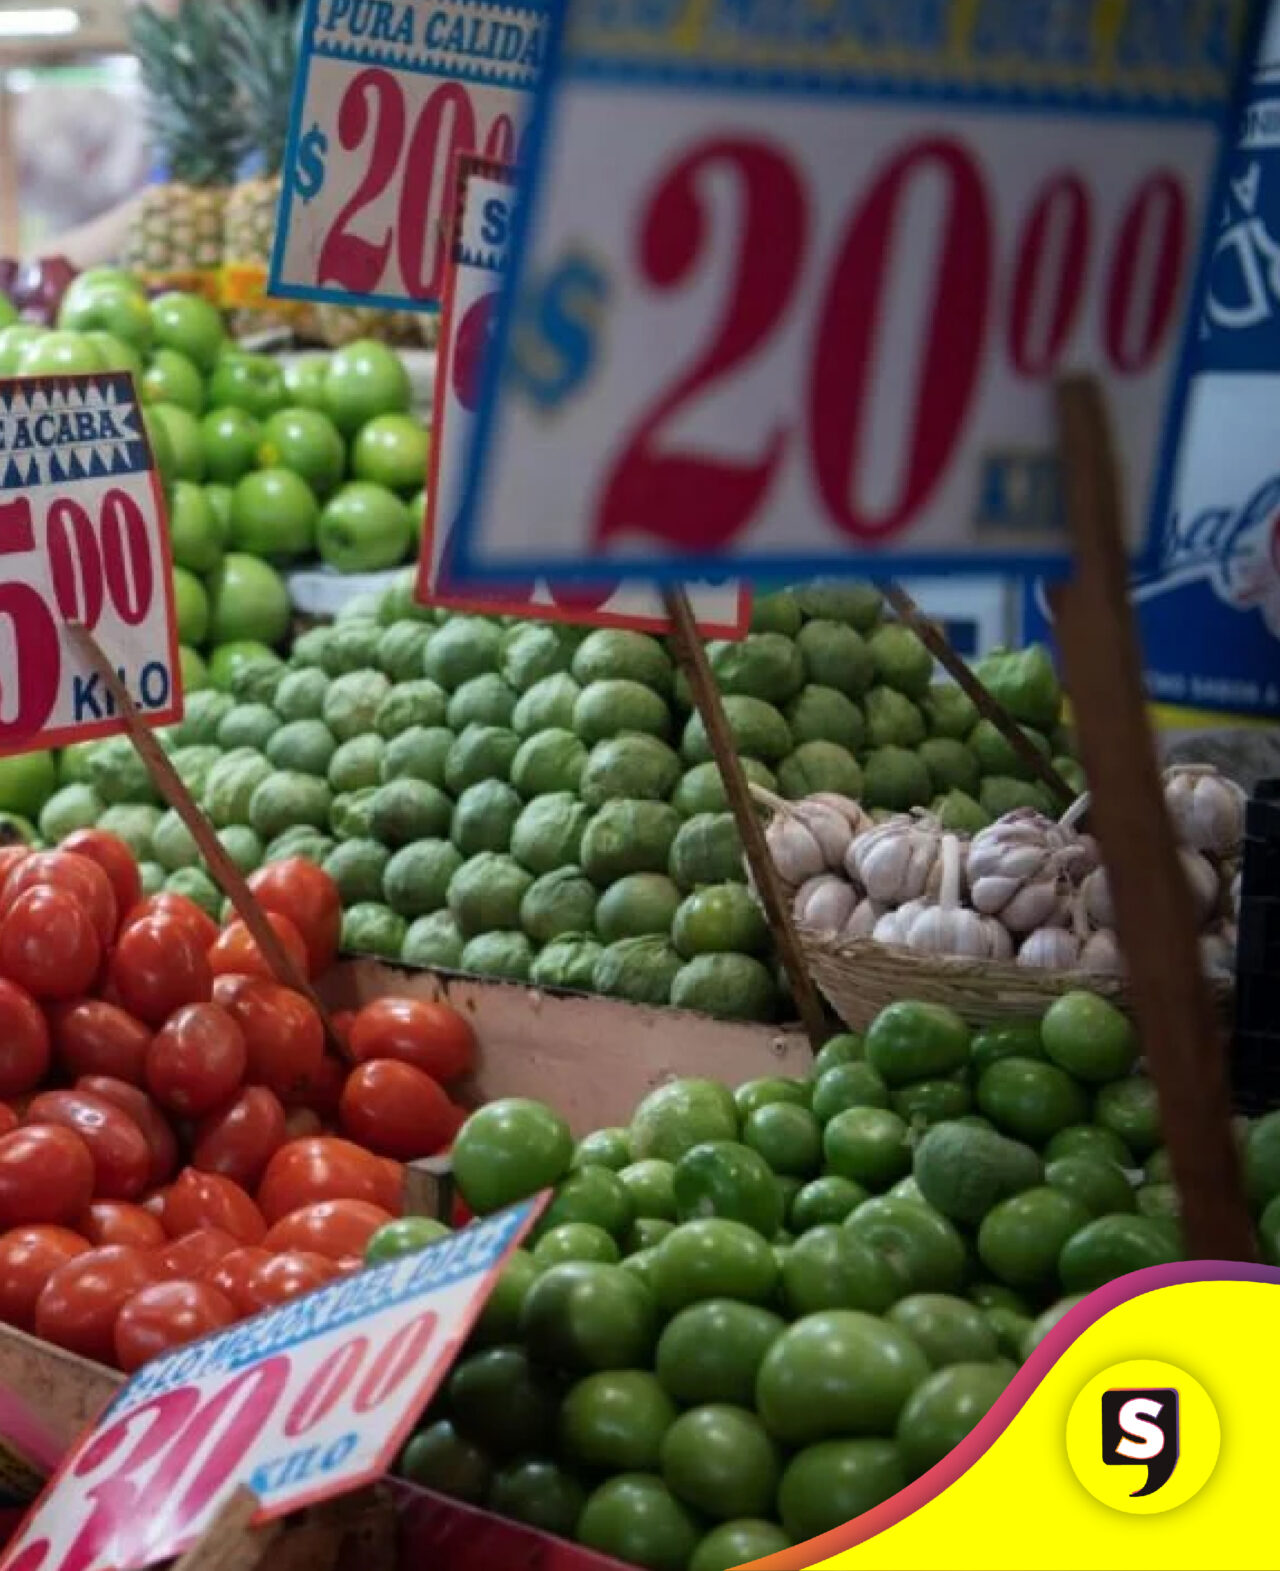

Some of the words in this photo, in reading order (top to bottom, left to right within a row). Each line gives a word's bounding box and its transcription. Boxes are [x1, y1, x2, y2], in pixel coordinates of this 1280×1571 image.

[323, 0, 414, 46] PURA
[425, 11, 542, 65] CALIDA
[12, 408, 122, 450] ACABA
[250, 1431, 359, 1493] KILO
